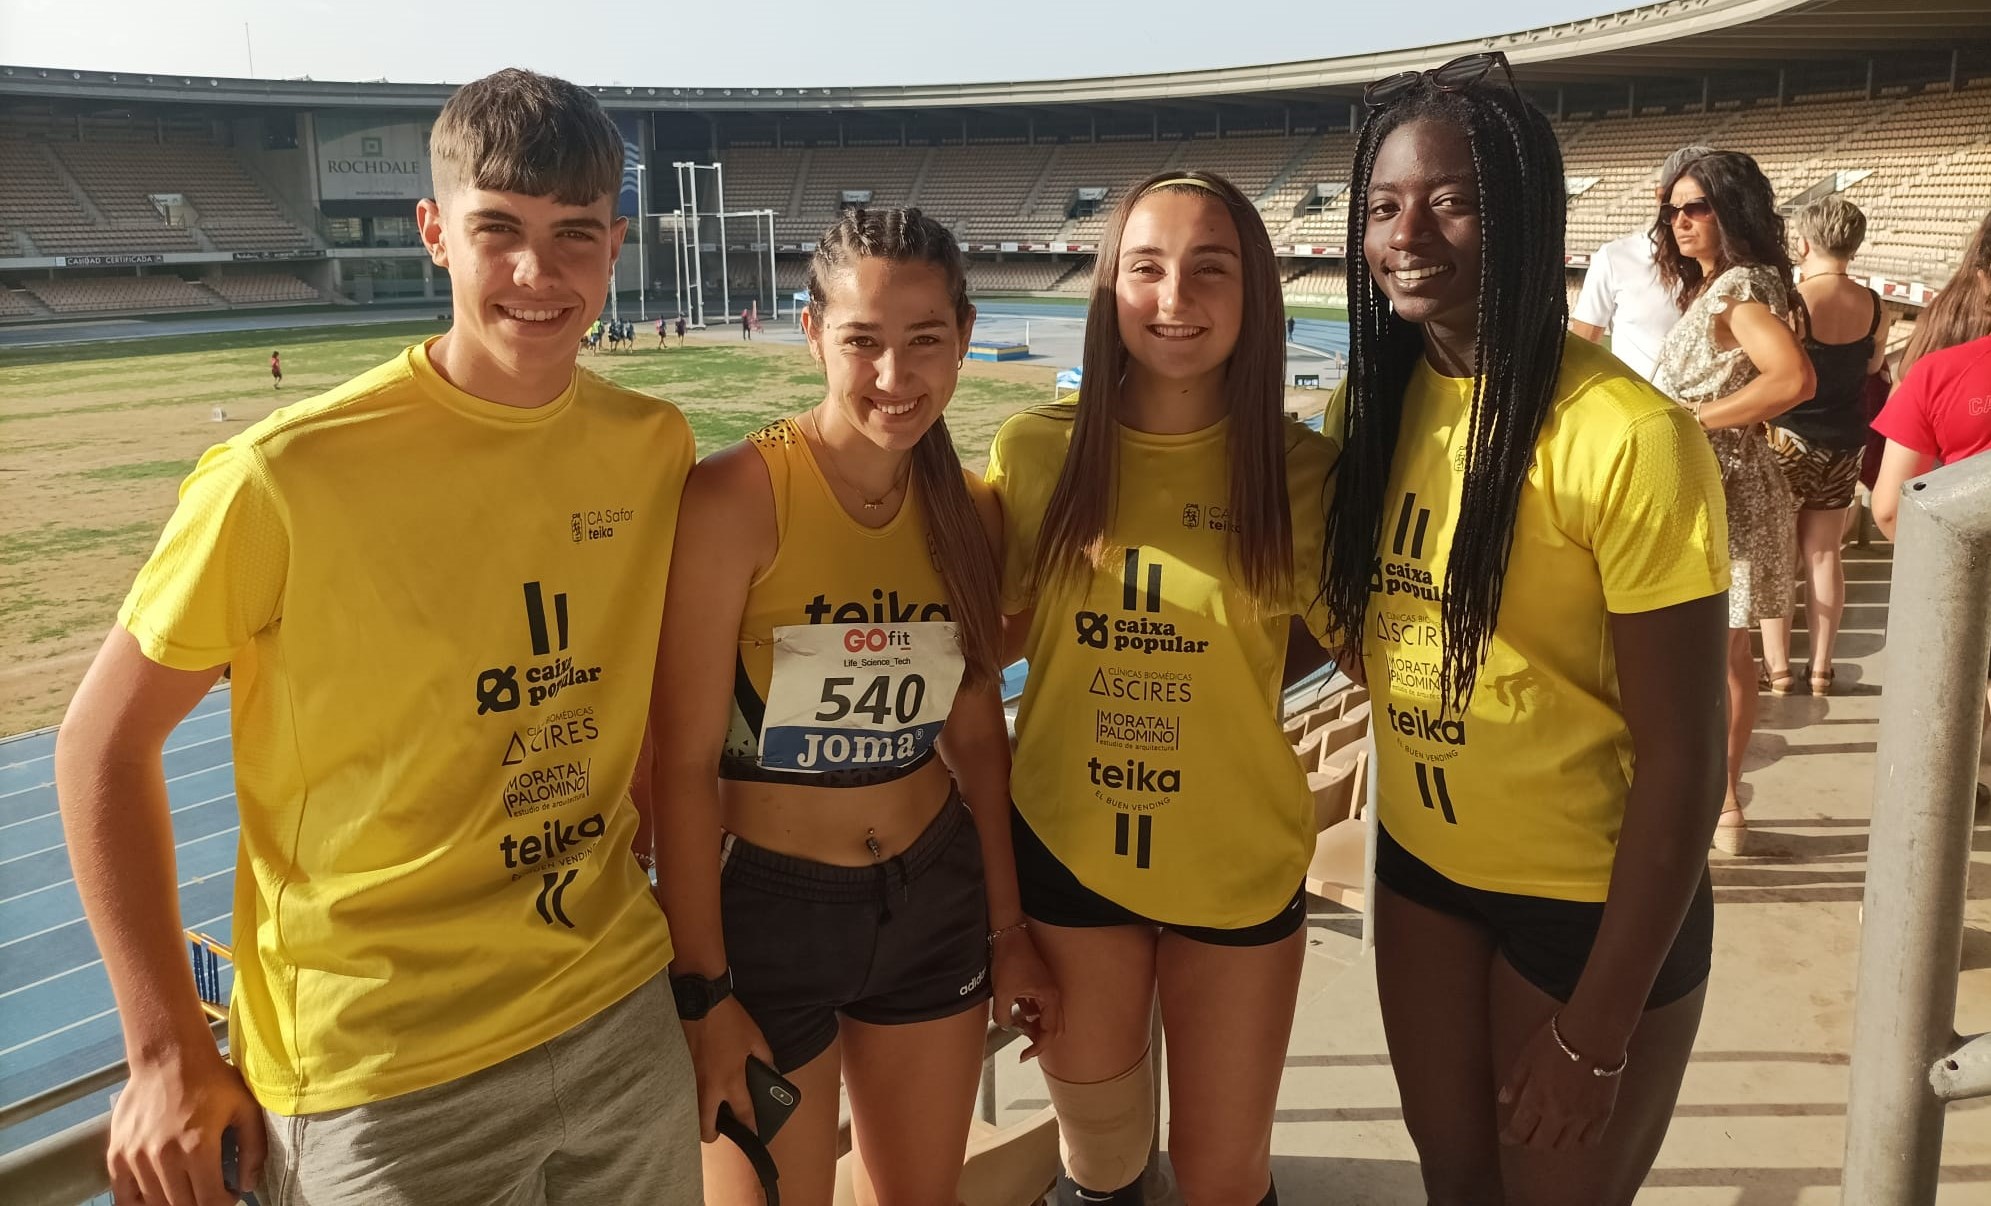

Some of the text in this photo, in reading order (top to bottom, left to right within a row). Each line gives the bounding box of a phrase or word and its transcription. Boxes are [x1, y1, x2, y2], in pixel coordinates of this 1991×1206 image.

[328, 160, 420, 174] ROCHDALE
[588, 509, 634, 525] CA Safor
[588, 526, 613, 540] teika
[1385, 563, 1433, 585] caixa
[1385, 578, 1442, 602] popul
[1114, 618, 1175, 636] caixa
[1377, 611, 1439, 647] ASCIR
[1114, 634, 1209, 654] popular
[1108, 666, 1142, 679] CLÍNICAS
[1389, 656, 1441, 677] MORATA
[1391, 670, 1441, 691] PALOMIN
[815, 673, 926, 724] 540
[1100, 710, 1174, 730] MORATAL
[1387, 702, 1466, 745] teika
[1100, 724, 1174, 744] PALOMINO
[1100, 739, 1122, 749] estudio
[1124, 742, 1133, 750] de
[1425, 749, 1458, 762] VENDING
[507, 761, 586, 792] MORATAL
[1088, 756, 1181, 793] teika
[507, 777, 586, 808] PALOMINO
[1095, 790, 1171, 812] EL BUEN VENDING
[541, 802, 550, 811] de
[500, 813, 606, 869] teika
